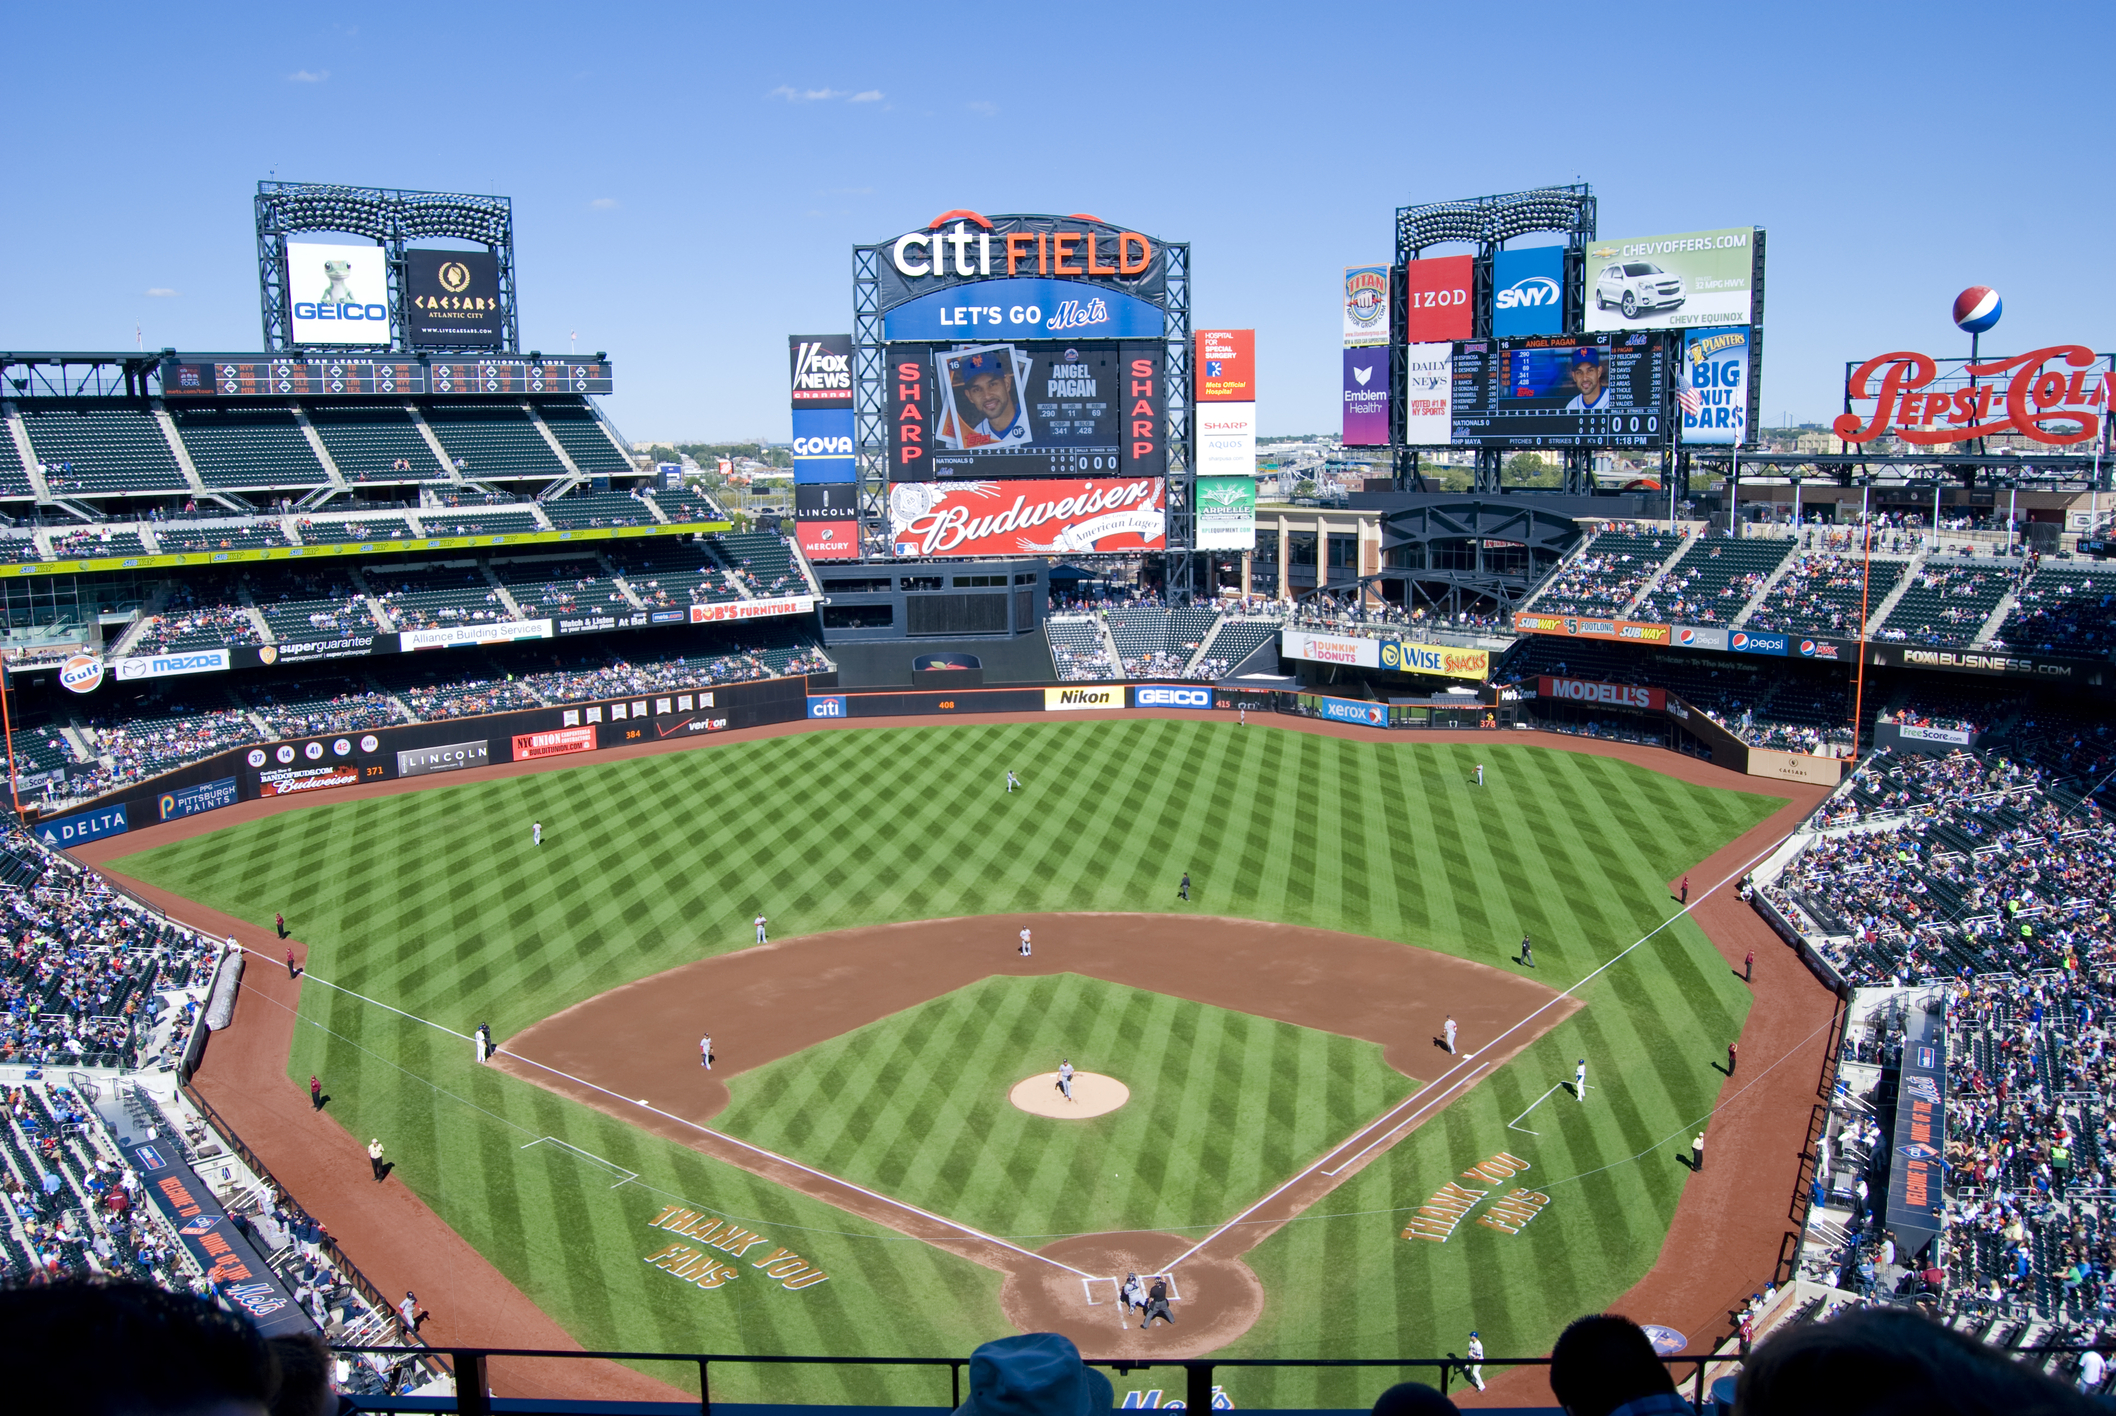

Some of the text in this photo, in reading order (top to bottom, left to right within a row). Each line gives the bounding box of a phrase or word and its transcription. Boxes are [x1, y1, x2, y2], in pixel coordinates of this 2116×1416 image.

[893, 220, 1152, 277] citi FIELD
[1622, 233, 1747, 257] CHEVYOFFERS.COM
[1349, 274, 1384, 292] TITAN
[1694, 278, 1746, 290] 32 MPG HWY.
[414, 295, 497, 311] CAESARS
[1413, 288, 1467, 309] IZOD
[1495, 285, 1551, 310] SNY
[294, 302, 387, 321] GEICO
[428, 311, 465, 319] ATLANTIC
[940, 298, 1109, 331] LET'S GO Mets
[1669, 312, 1744, 325] CHEVY EQUINOX
[421, 327, 493, 335] WWW.LIVECAESARS.COM
[1526, 340, 1549, 348] ANGEL
[1597, 336, 1607, 344] CF
[1701, 334, 1746, 354] PLANTERS
[810, 355, 849, 373] FOX
[949, 361, 960, 370] 16
[1053, 364, 1091, 379] ANGEL
[1412, 362, 1446, 371] DAILY
[800, 373, 851, 389] NEWS
[1412, 377, 1447, 386] NEWS
[1692, 359, 1740, 389] BIG
[794, 391, 851, 399] channel
[1047, 379, 1097, 398] PAGAN
[1205, 388, 1233, 396] Hospital
[1345, 389, 1386, 401] Emblem
[1411, 399, 1447, 408] VOTED IN
[1700, 389, 1733, 406] NUT
[898, 362, 923, 464] SHARP
[1131, 359, 1155, 460] SHARP
[1350, 402, 1381, 413] Health
[1412, 407, 1445, 416] NY SPORTS
[1647, 416, 1657, 432] 0
[1684, 406, 1744, 429] BARS
[1204, 421, 1248, 430] SHARP
[793, 436, 853, 456] GOYA
[1208, 440, 1243, 449] AQUOS
[1615, 437, 1632, 445] 1:18
[1634, 437, 1647, 445] PM
[799, 508, 855, 517] LINCOLN
[907, 480, 1149, 555] Budweiser
[1202, 506, 1251, 514] ARPIELLE
[1074, 517, 1160, 543] American Lager
[427, 538, 455, 548] SUBWAY
[492, 535, 518, 544] SUBWAY
[806, 542, 849, 550] MERCURY
[290, 546, 319, 556] SUBWAY
[361, 543, 389, 552] SUBWAY
[123, 556, 155, 567] SUBWAY
[213, 551, 245, 561] SUBWAY
[20, 563, 54, 574] SUBWAY
[748, 599, 788, 607] DISCOUNT
[654, 612, 682, 621] mets.com
[692, 604, 738, 622] BOB'S
[739, 603, 797, 617] FURNITURE
[560, 617, 615, 628] Watch Listen
[618, 617, 647, 627] At Bat
[1518, 617, 1668, 640] SUBWAY $5 FOOTLONG SUBWAY
[413, 624, 542, 644] Alliance Building Services
[1696, 636, 1720, 646] pepsi
[279, 636, 373, 654] superguarantee
[1317, 640, 1358, 654] DUNKIN'
[1750, 638, 1784, 651] pepsi
[1815, 645, 1839, 656] MAX
[153, 654, 223, 672] mazda
[1317, 650, 1357, 663] DONUTS
[1403, 647, 1487, 674] WISE SNACKS
[1903, 649, 2072, 677] FOX BUSINESS.COM
[63, 662, 100, 685] Gulf
[1060, 689, 1110, 704] Nikon
[1138, 689, 1209, 705] GEICO
[1519, 688, 1537, 700] Zone
[1552, 678, 1650, 708] MODELL'S
[813, 701, 839, 717] citi
[939, 701, 955, 709] 408
[1216, 700, 1231, 708] 415
[1328, 702, 1367, 720] xerox
[688, 718, 727, 731] verizon
[1480, 720, 1497, 728] 378
[626, 729, 641, 739] 384
[1903, 727, 1963, 742] FreeScore.com
[281, 750, 291, 759] 14
[309, 746, 320, 756] 41
[336, 742, 347, 752] 42
[529, 742, 583, 756] BUILDITUNION.COM
[252, 753, 263, 763] 37
[409, 747, 488, 767] LINCOLN
[260, 767, 334, 783] BANDOFBUDS.COM
[366, 766, 384, 776] 371
[1778, 767, 1808, 776] CAESARS
[199, 783, 214, 792] PPG
[272, 774, 357, 794] Budweiser
[178, 785, 236, 808] PITTSBURGH
[185, 795, 231, 814] PAINTS
[62, 812, 125, 840] DELTA
[1905, 1075, 1942, 1105] Mets
[1910, 1100, 1933, 1143] HOME OF THE
[1906, 1160, 1928, 1207] WELCOME TO
[157, 1175, 202, 1218] WELCOME TO
[1401, 1151, 1531, 1243] THANK YOU
[1475, 1187, 1551, 1235] FANS
[198, 1231, 232, 1257] HOME
[648, 1205, 830, 1290] THANK YOU
[643, 1242, 740, 1290] FANS
[224, 1282, 288, 1317] Mets
